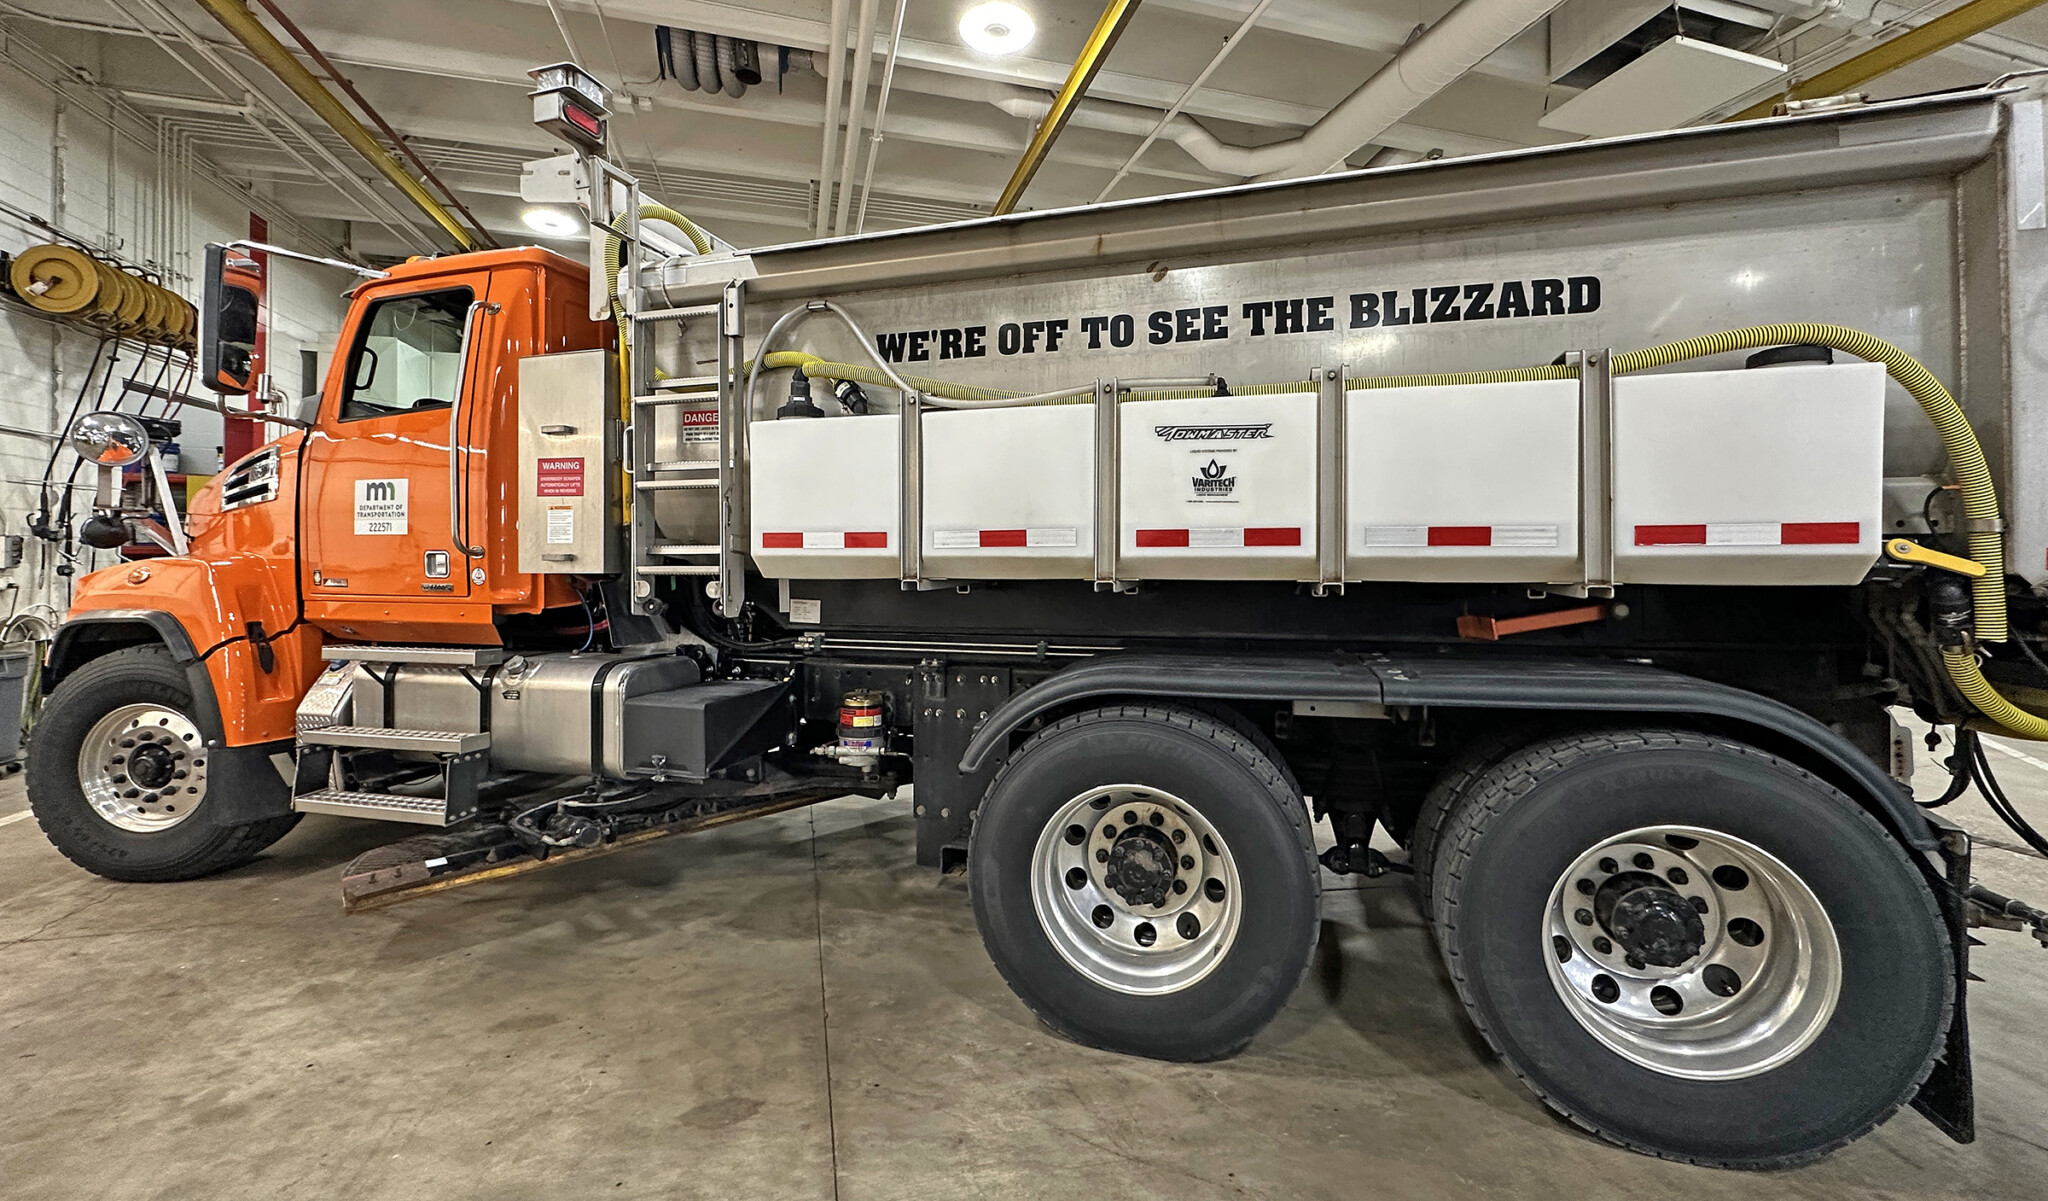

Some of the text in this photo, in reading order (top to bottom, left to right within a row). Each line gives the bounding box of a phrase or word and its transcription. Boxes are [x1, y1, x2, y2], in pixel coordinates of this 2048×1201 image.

[876, 275, 1601, 364] WE'RE OFF TO SEE THE BLIZZARD
[684, 412, 719, 423] DANGE
[1155, 423, 1275, 441] TOWMASTER
[542, 461, 580, 470] WARNING
[1191, 476, 1235, 488] VARITECH
[369, 522, 392, 532] 222571
